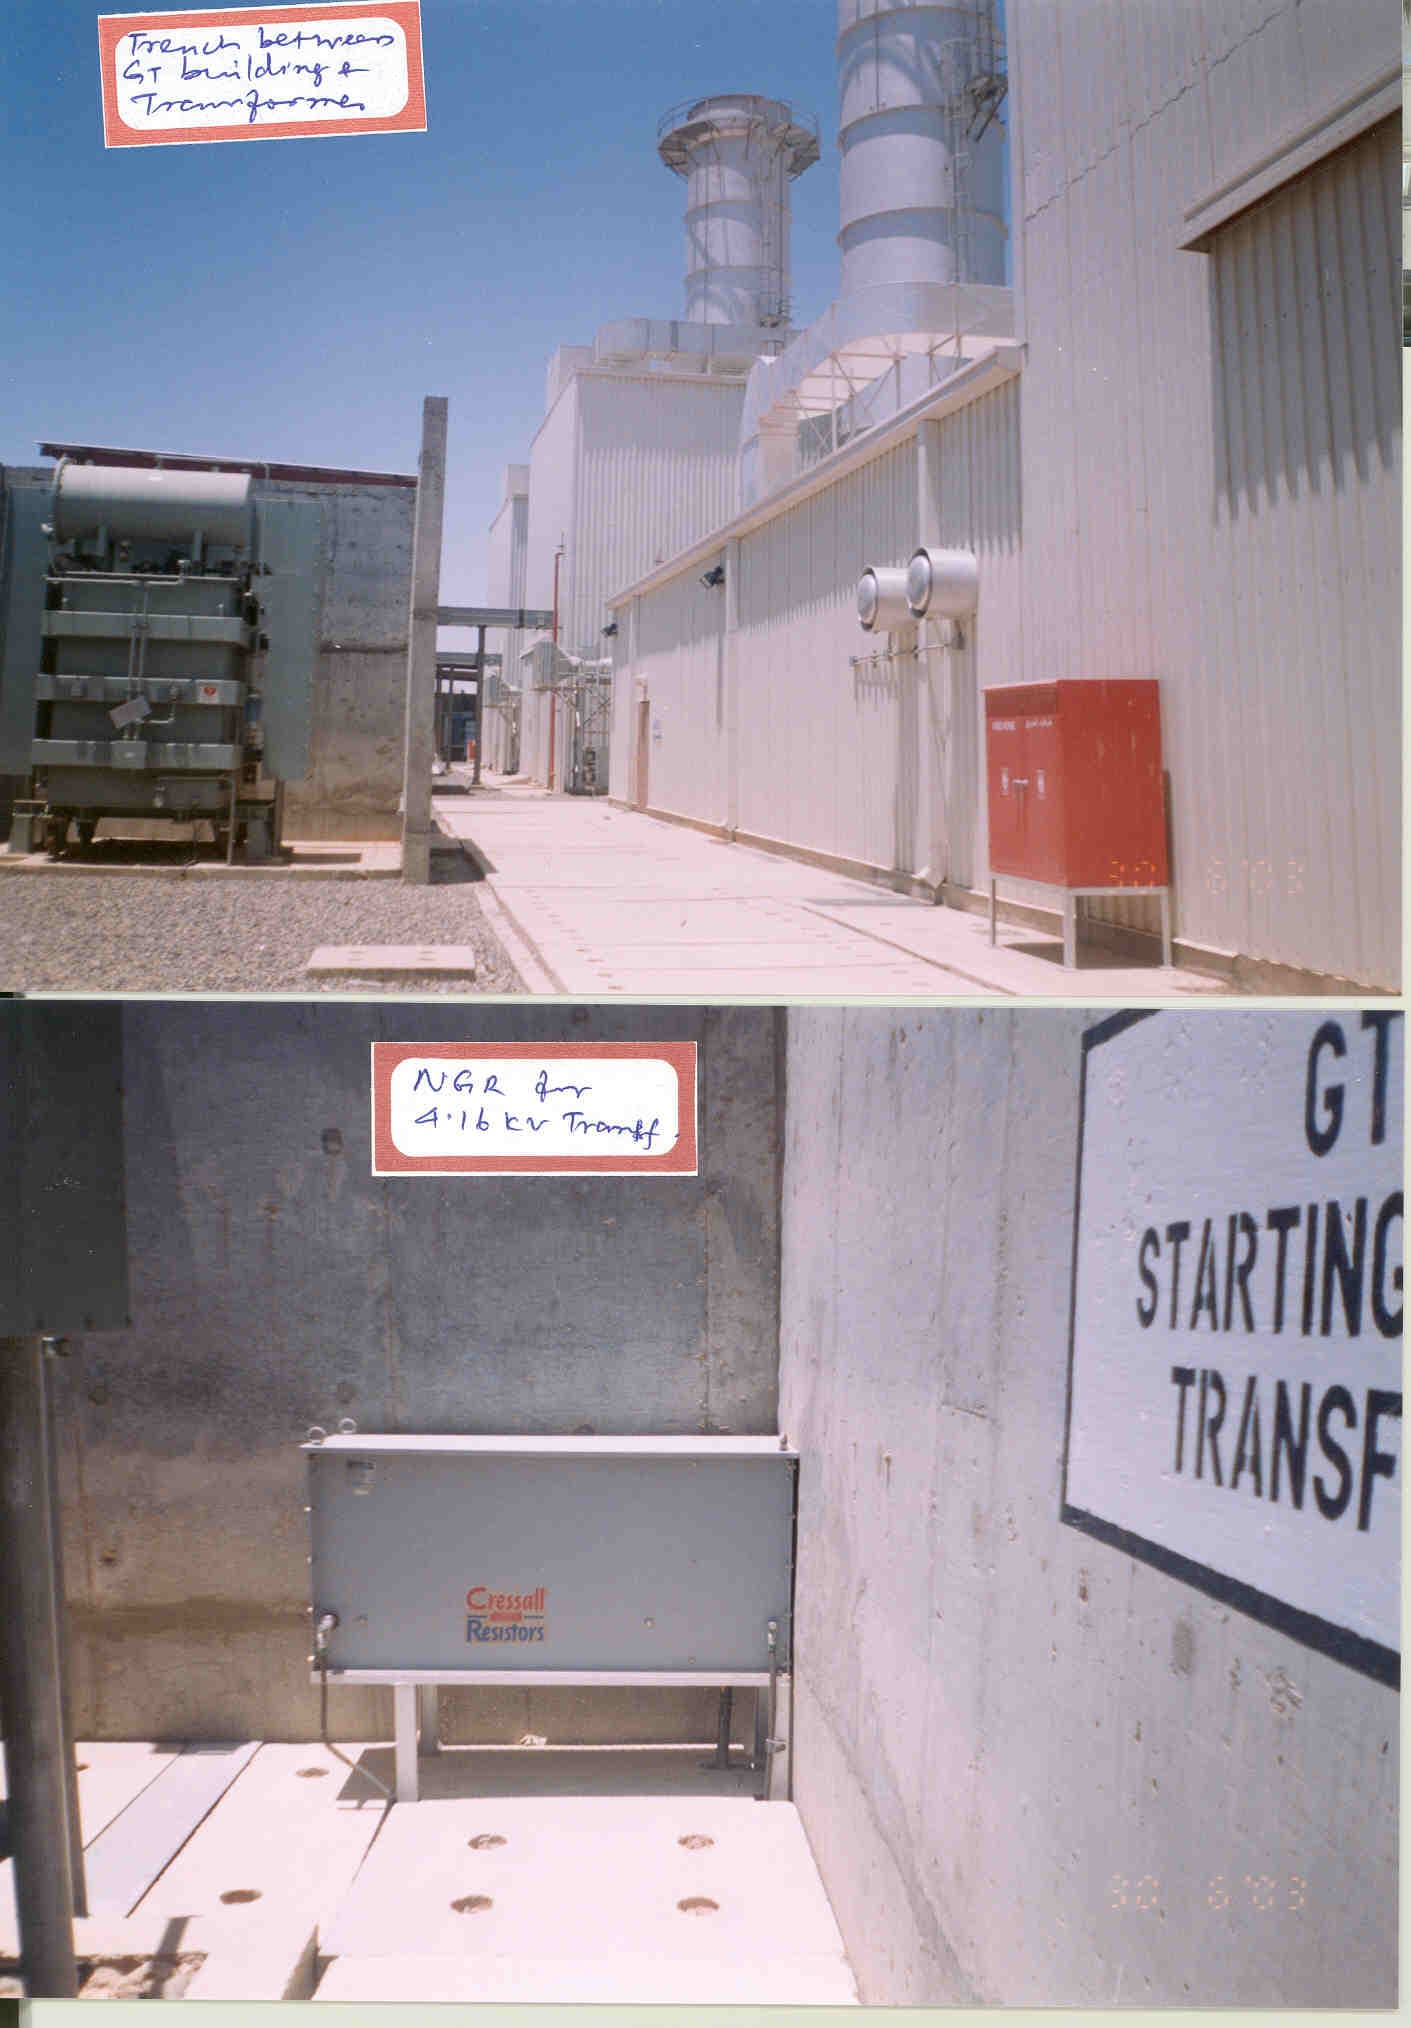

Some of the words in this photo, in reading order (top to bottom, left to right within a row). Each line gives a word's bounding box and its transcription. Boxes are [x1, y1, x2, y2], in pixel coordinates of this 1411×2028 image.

[128, 33, 241, 55] Trench
[259, 26, 395, 50] between
[122, 60, 162, 84] GT
[181, 52, 330, 87] building
[413, 1068, 506, 1095] NGR
[1304, 1009, 1404, 1158] GT
[1136, 1190, 1404, 1339] STARTING
[1171, 1366, 1404, 1531] TRANSF
[466, 1586, 546, 1611] Cressall
[466, 1619, 545, 1642] Resistors
